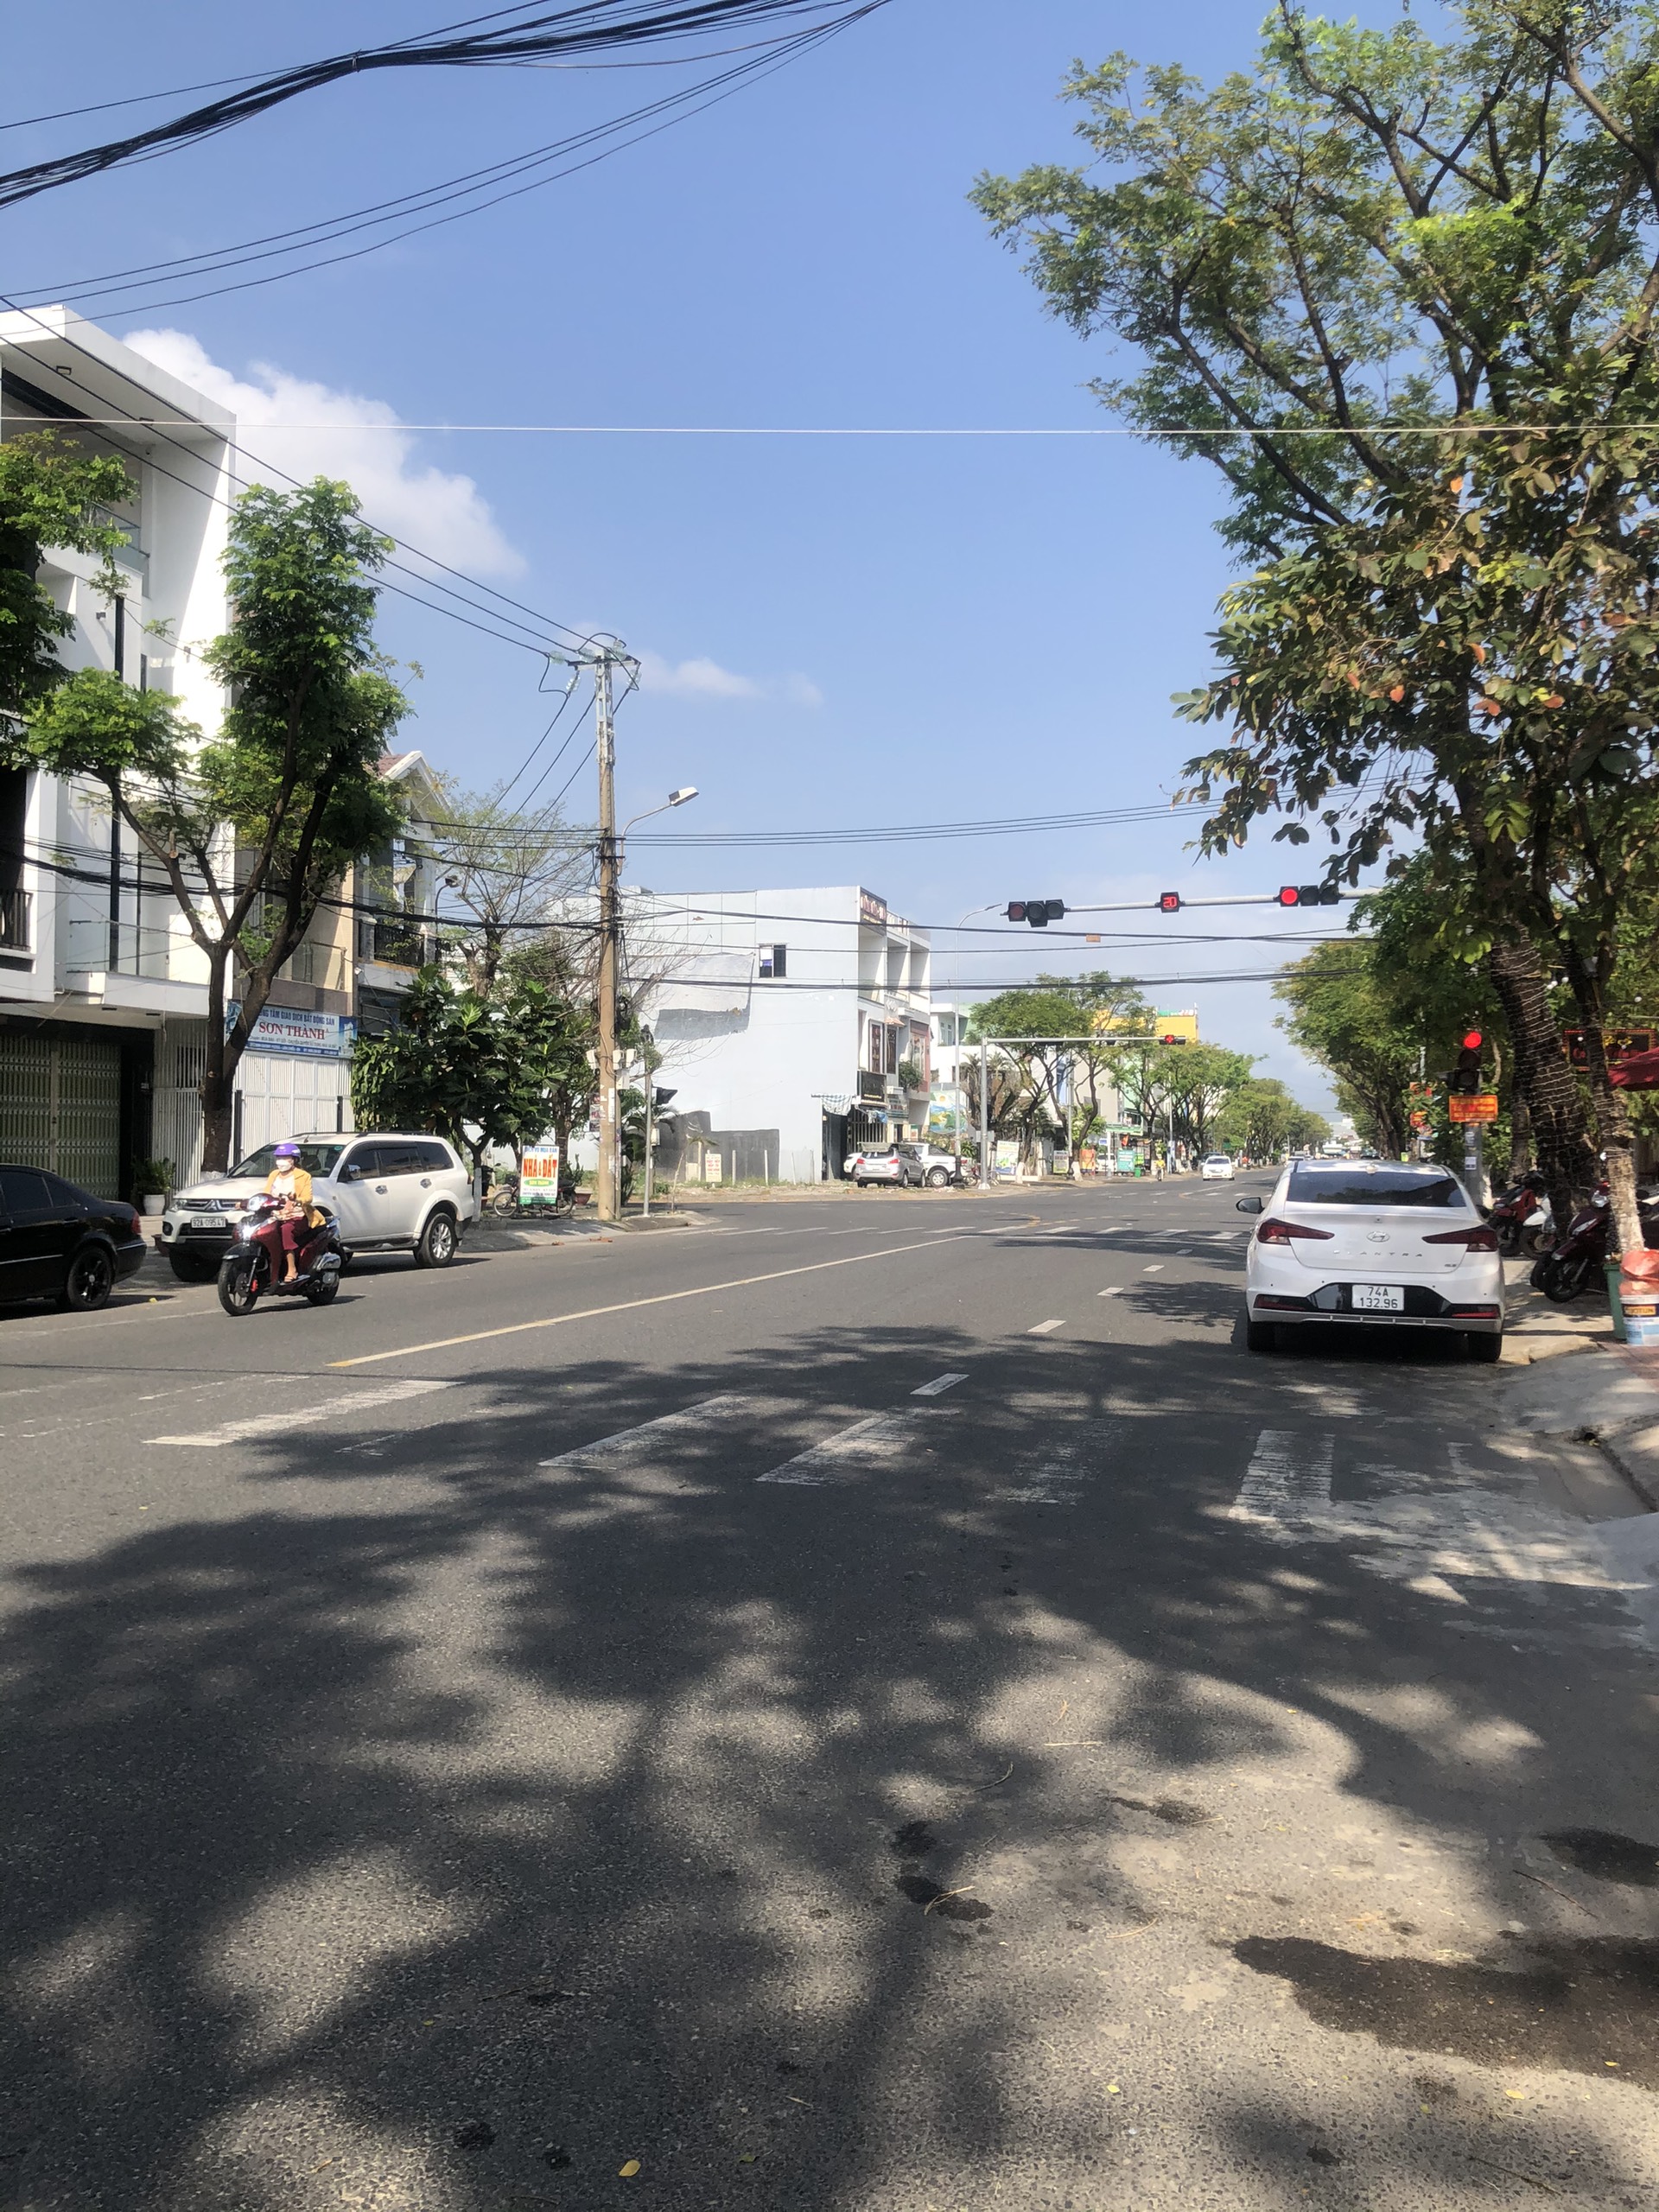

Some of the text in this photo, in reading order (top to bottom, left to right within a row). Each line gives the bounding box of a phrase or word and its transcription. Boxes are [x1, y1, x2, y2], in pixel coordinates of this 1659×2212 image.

[1163, 896, 1177, 907] 20
[281, 1010, 292, 1020] GIAO
[292, 1012, 303, 1022] DỊCH
[259, 1022, 325, 1039] SƠN THÀNH
[543, 1154, 557, 1178] ĐẤT
[1368, 1287, 1389, 1296] 74A
[1360, 1297, 1398, 1308] 132.96
